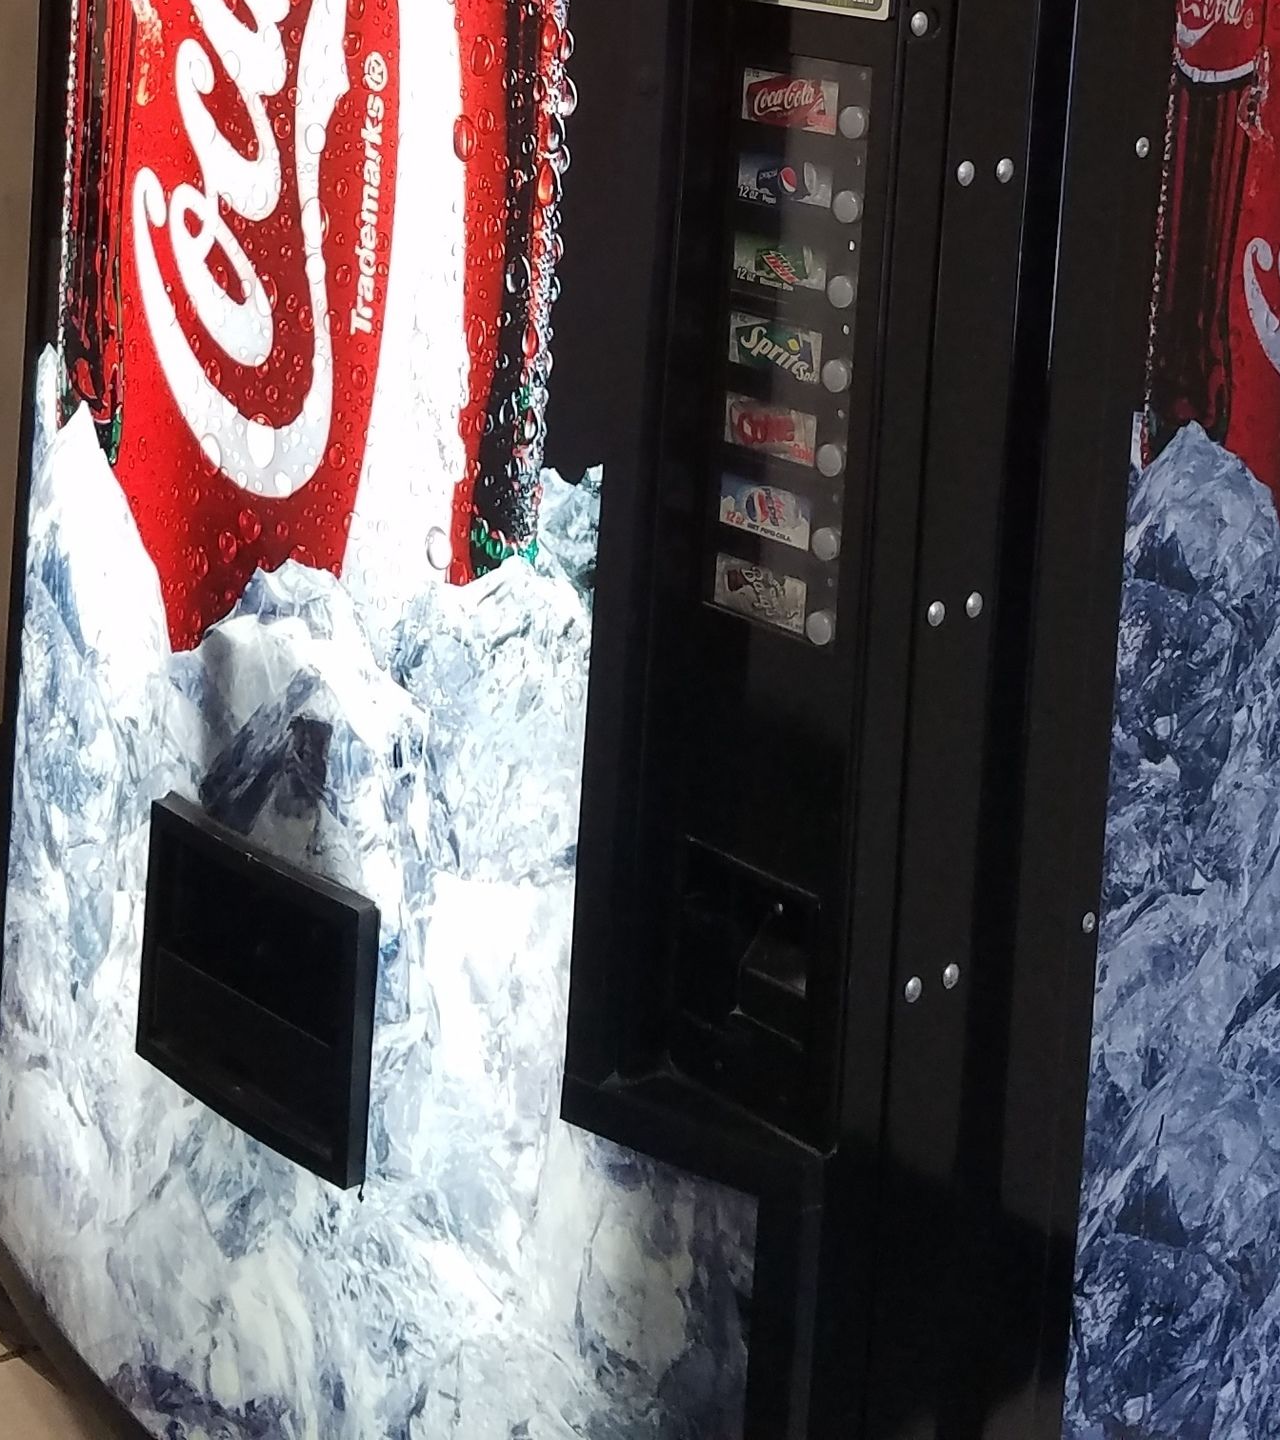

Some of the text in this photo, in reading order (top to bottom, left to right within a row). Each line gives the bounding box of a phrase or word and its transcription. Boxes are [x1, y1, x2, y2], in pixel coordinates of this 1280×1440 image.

[753, 78, 815, 117] Coca-Cola
[738, 184, 749, 198] 12
[736, 266, 747, 280] 12
[740, 326, 809, 375] Sprite
